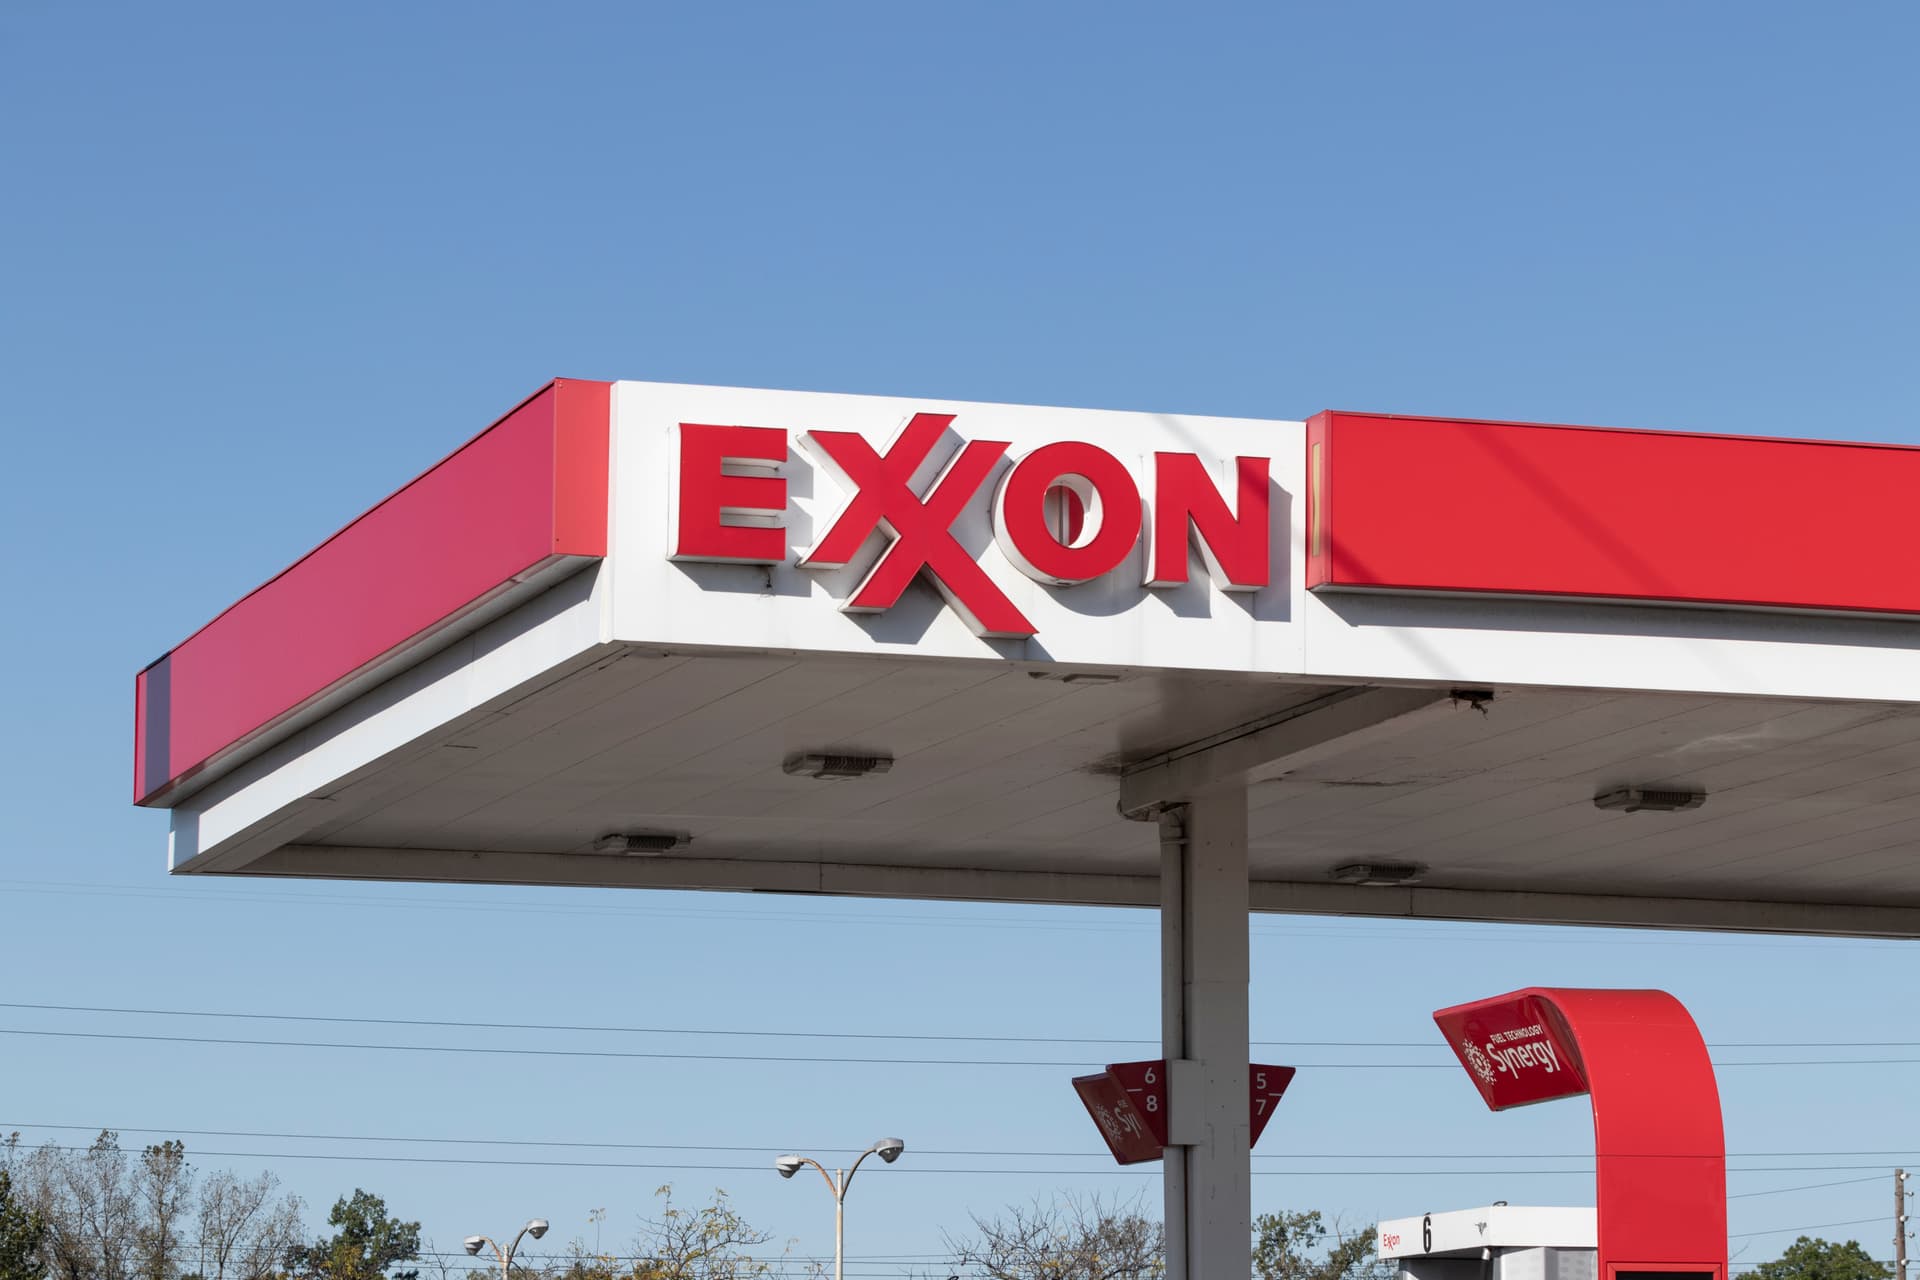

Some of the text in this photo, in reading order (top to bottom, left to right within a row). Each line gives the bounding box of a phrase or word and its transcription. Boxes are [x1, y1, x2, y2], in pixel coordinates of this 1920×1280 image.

[672, 412, 1272, 638] EXXON
[1490, 1024, 1543, 1044] FUEL TECHNOLOGY
[1486, 1039, 1561, 1080] Synergy
[1144, 1067, 1156, 1084] 6
[1256, 1072, 1267, 1089] 5
[1146, 1095, 1158, 1112] 8
[1256, 1099, 1267, 1116] 7
[1423, 1216, 1432, 1253] 6
